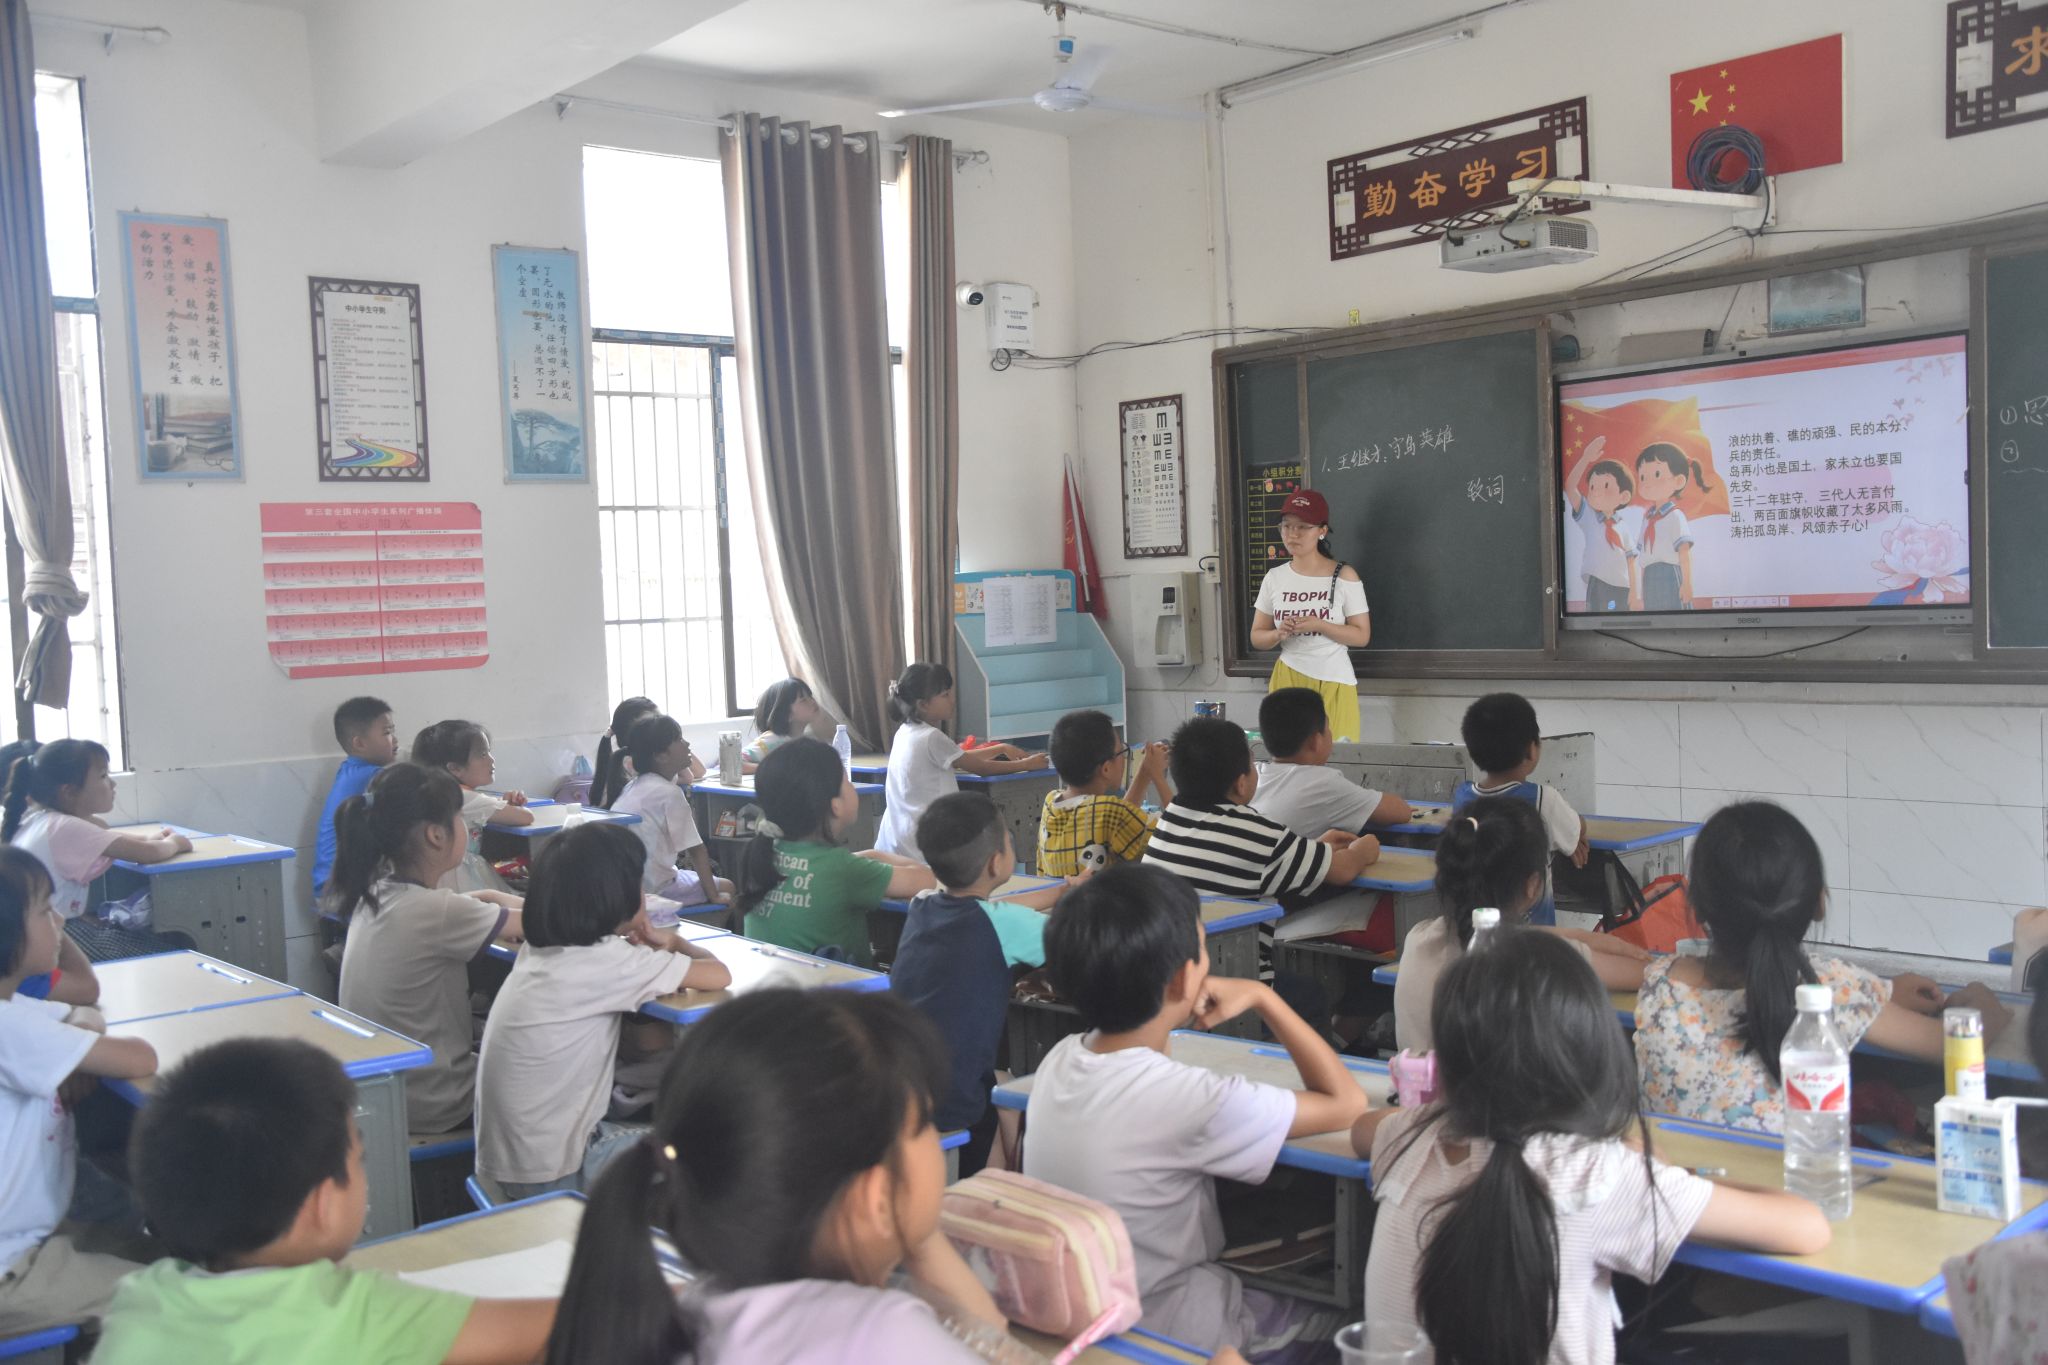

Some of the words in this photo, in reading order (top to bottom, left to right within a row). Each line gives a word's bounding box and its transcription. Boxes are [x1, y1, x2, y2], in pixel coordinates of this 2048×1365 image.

[1362, 145, 1548, 220] 勤奋学习
[1729, 446, 1782, 463] 兵的责任。
[1729, 480, 1759, 494] 先安。
[772, 851, 809, 871] ican
[793, 873, 814, 890] of
[764, 889, 812, 908] ment
